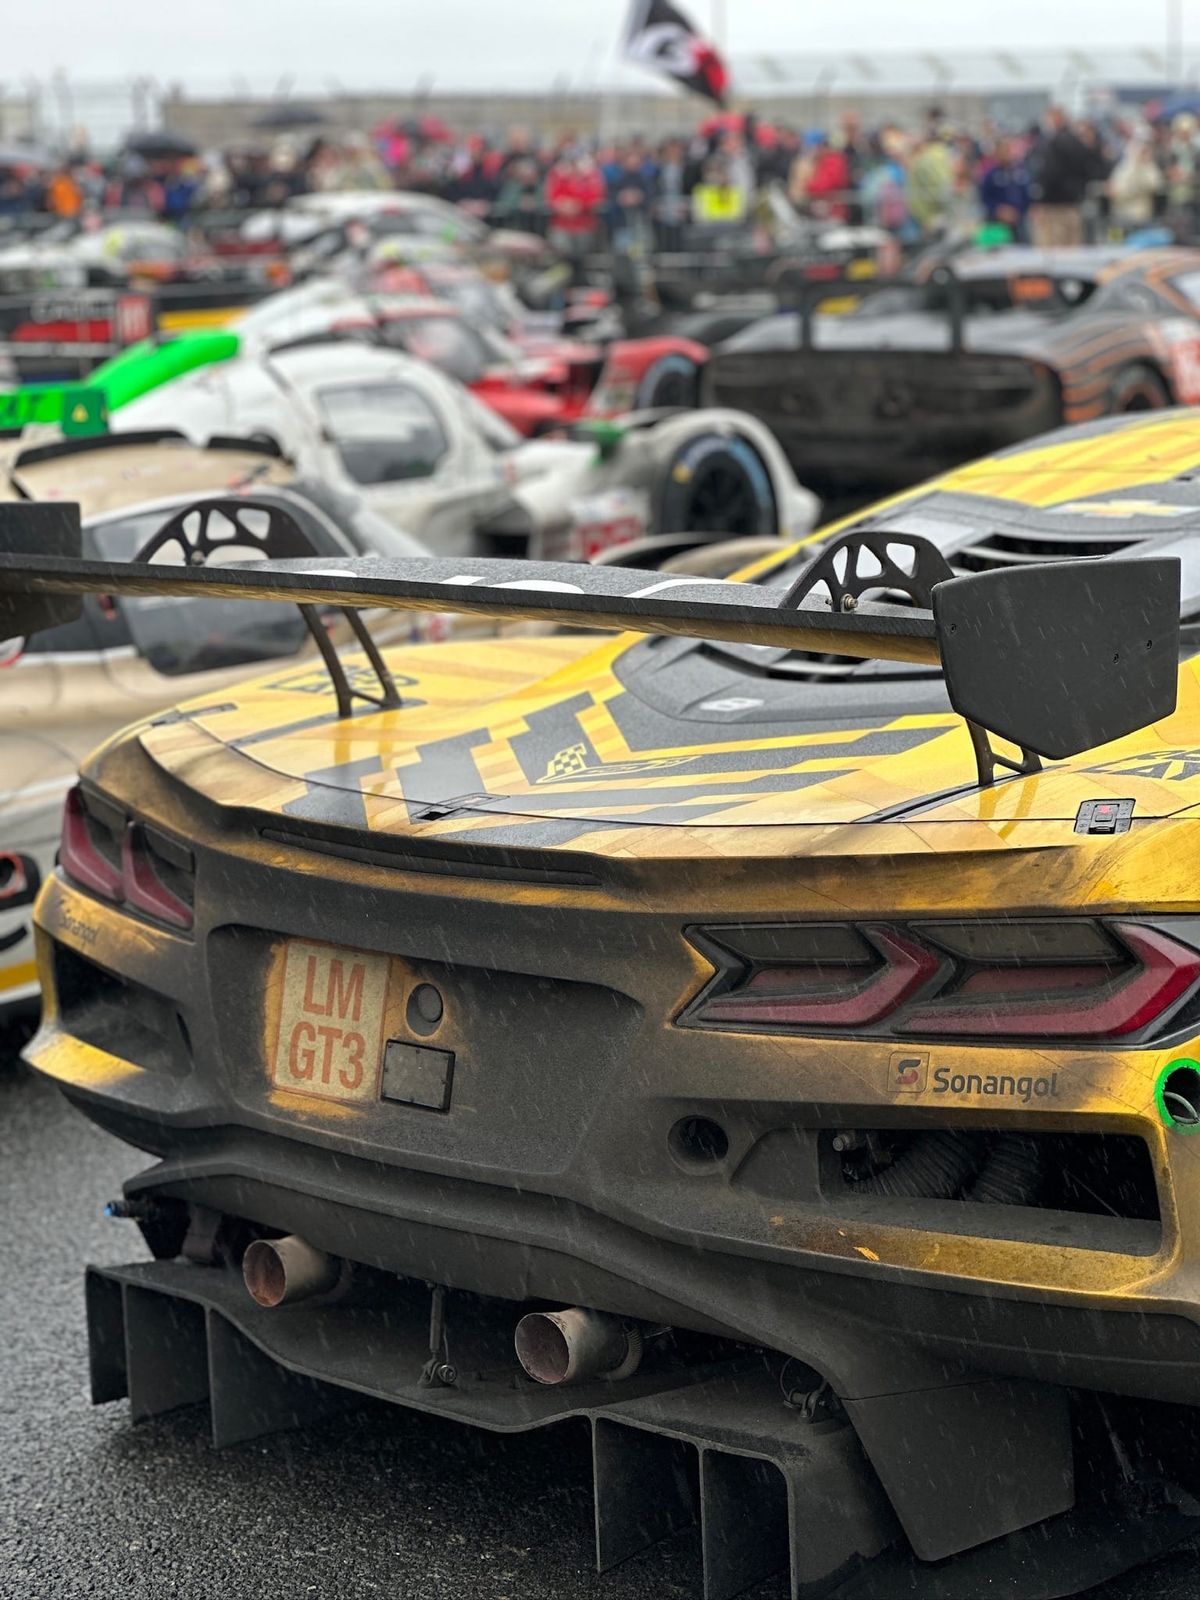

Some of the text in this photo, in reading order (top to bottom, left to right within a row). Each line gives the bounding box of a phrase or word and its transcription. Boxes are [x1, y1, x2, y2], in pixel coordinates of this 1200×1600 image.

[303, 955, 366, 1022] LM
[288, 1020, 366, 1090] GT3
[932, 1067, 1059, 1103] Sonangol
